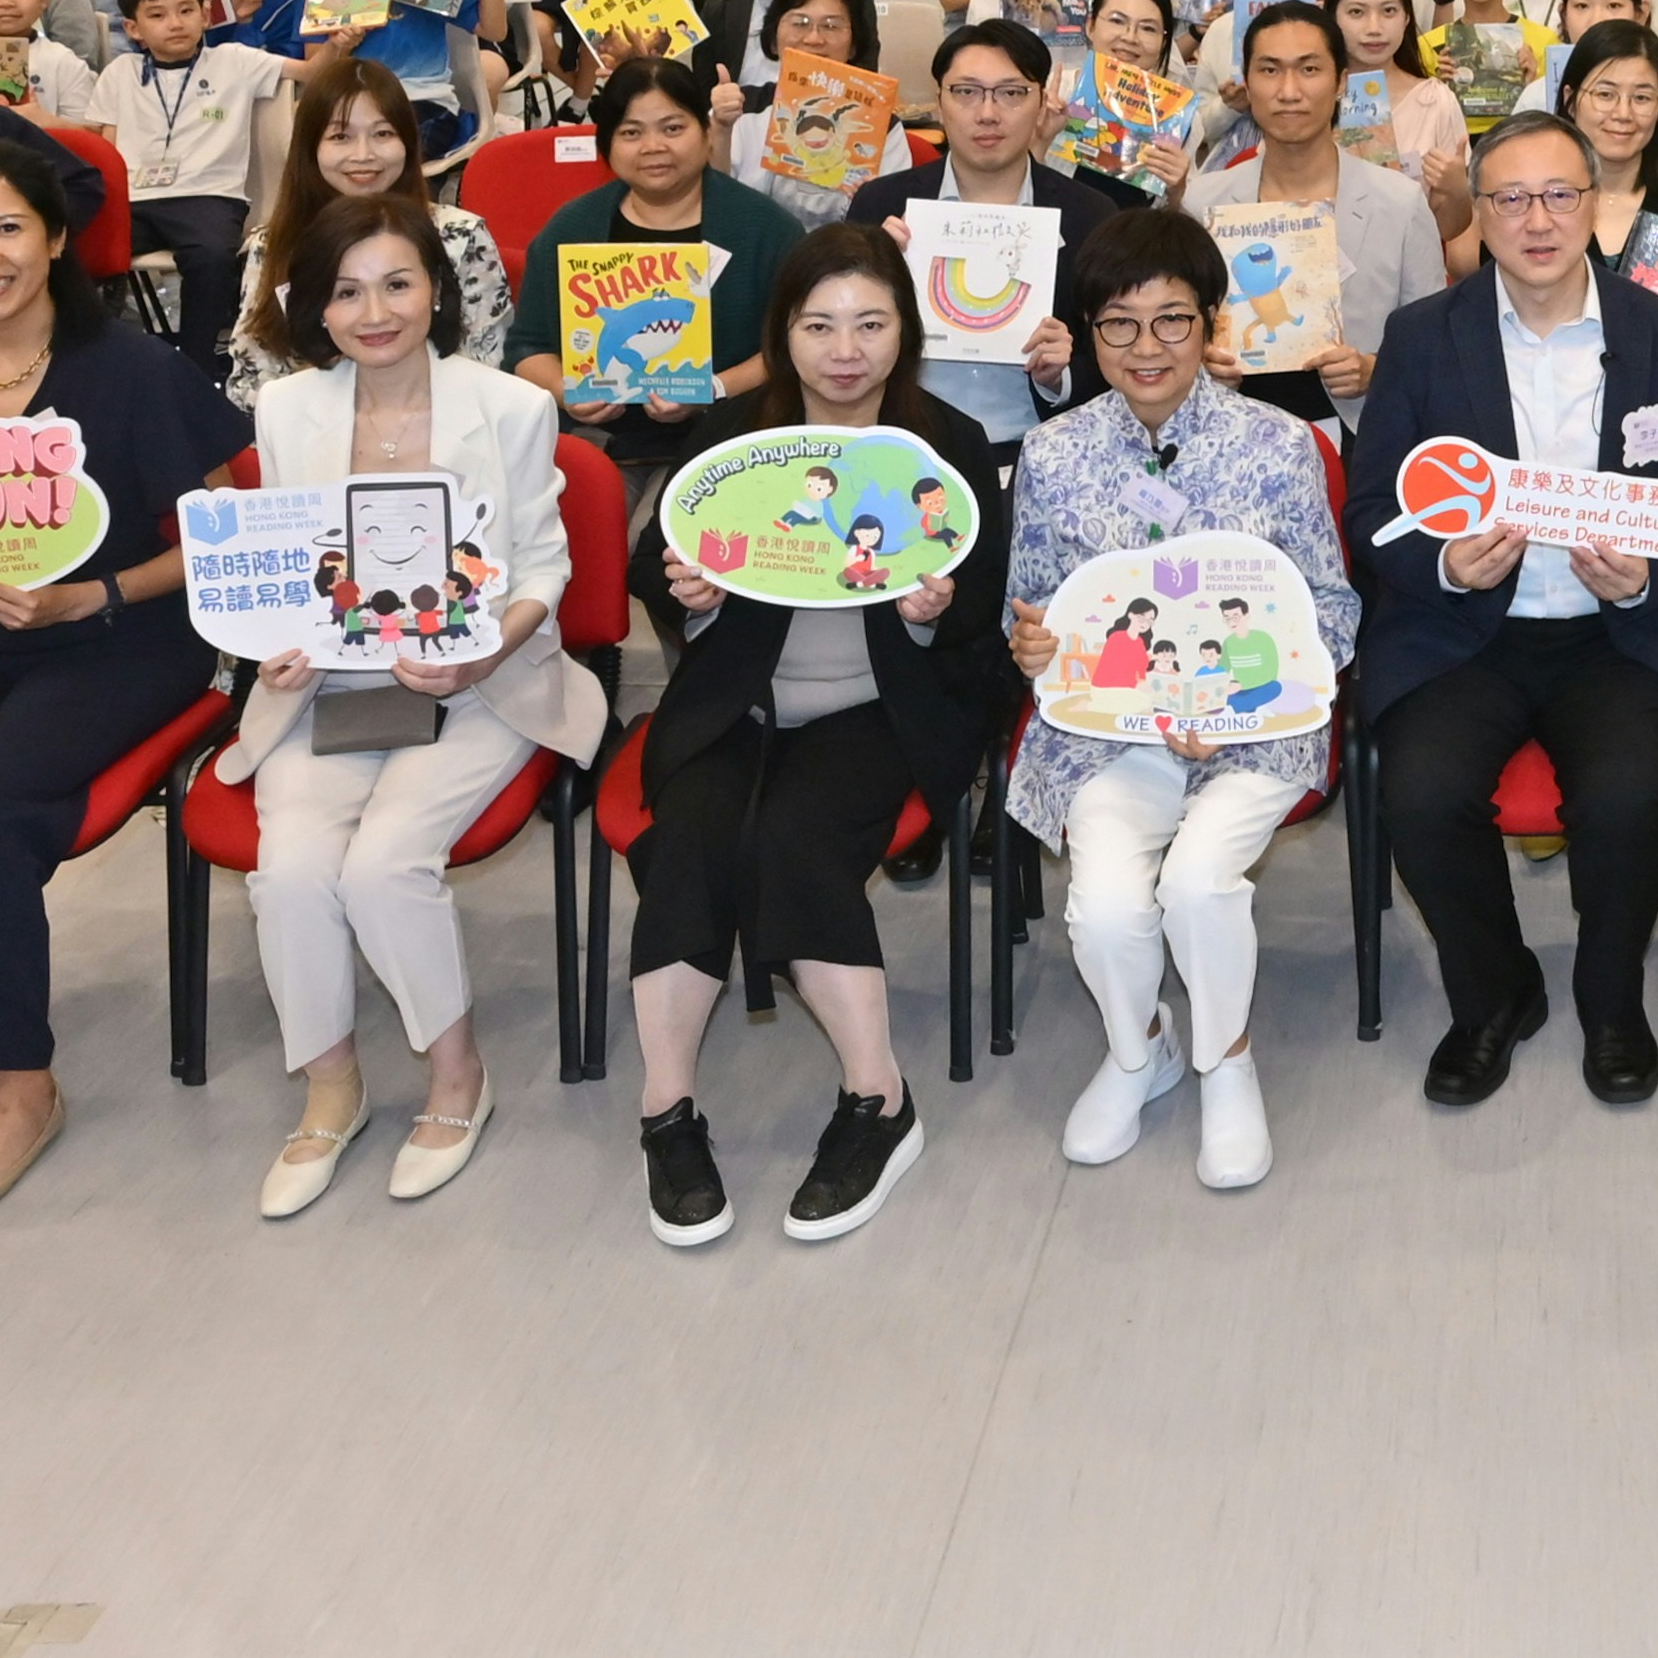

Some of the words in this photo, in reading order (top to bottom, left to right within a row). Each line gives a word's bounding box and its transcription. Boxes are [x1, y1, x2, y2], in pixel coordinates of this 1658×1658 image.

[1343, 102, 1378, 118] orning
[567, 258, 590, 272] THE
[591, 252, 635, 274] SNAPPY
[567, 250, 683, 319] SHARK
[675, 454, 745, 515] Anytime
[746, 436, 843, 467] Anywhere
[243, 491, 322, 511] 香港悅讀周
[1504, 495, 1570, 520] Leisure
[1575, 503, 1610, 524] and
[244, 512, 276, 523] HONG
[277, 509, 309, 521] KONG
[245, 523, 286, 534] READING
[287, 519, 324, 531] WEEK
[756, 536, 831, 555] 香港悅讀周
[191, 547, 312, 583] 隨時隨地
[754, 549, 785, 560] HONG
[786, 552, 815, 564] KONG
[2, 560, 41, 575] WEEK
[752, 561, 797, 572] READING
[798, 565, 827, 576] WEEK
[196, 579, 312, 615] 易讀易學
[1123, 715, 1150, 730] WE
[1176, 715, 1259, 733] READING
